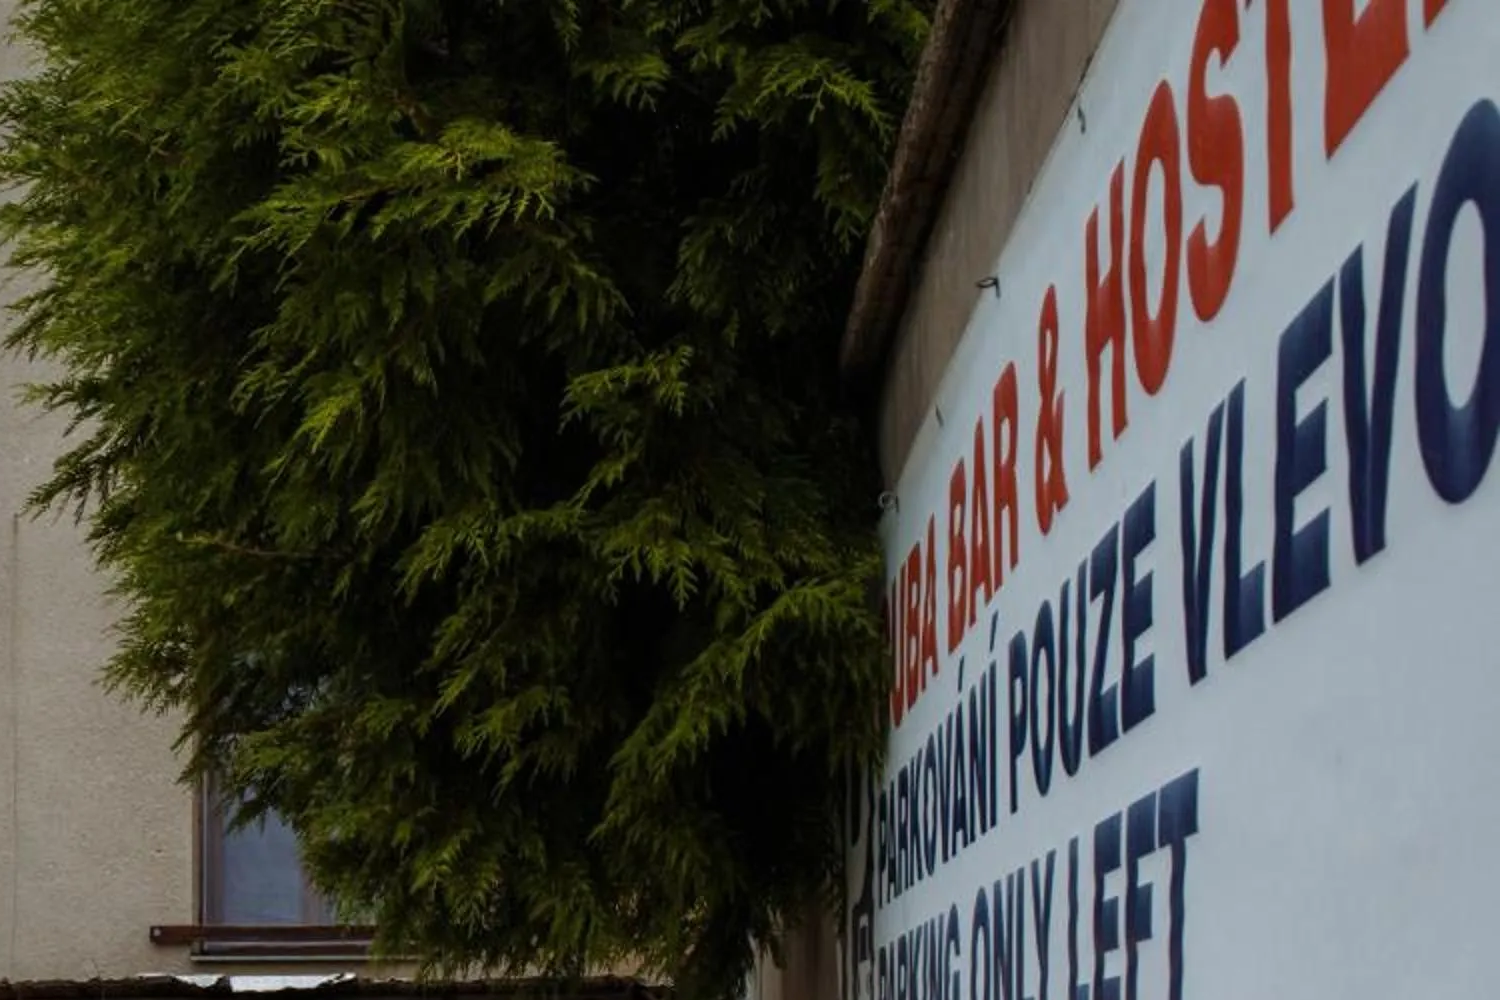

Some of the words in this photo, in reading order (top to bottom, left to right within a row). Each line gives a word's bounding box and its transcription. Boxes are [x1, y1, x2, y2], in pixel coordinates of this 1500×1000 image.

[877, 610, 998, 910] PARKOVÁNÍ
[1008, 479, 1156, 814] POUZE
[1179, 97, 1500, 686] VLEVO
[883, 512, 939, 729] UBA
[948, 360, 1018, 656] BAR
[1035, 283, 1070, 537] &
[1085, 0, 1448, 474] HOST
